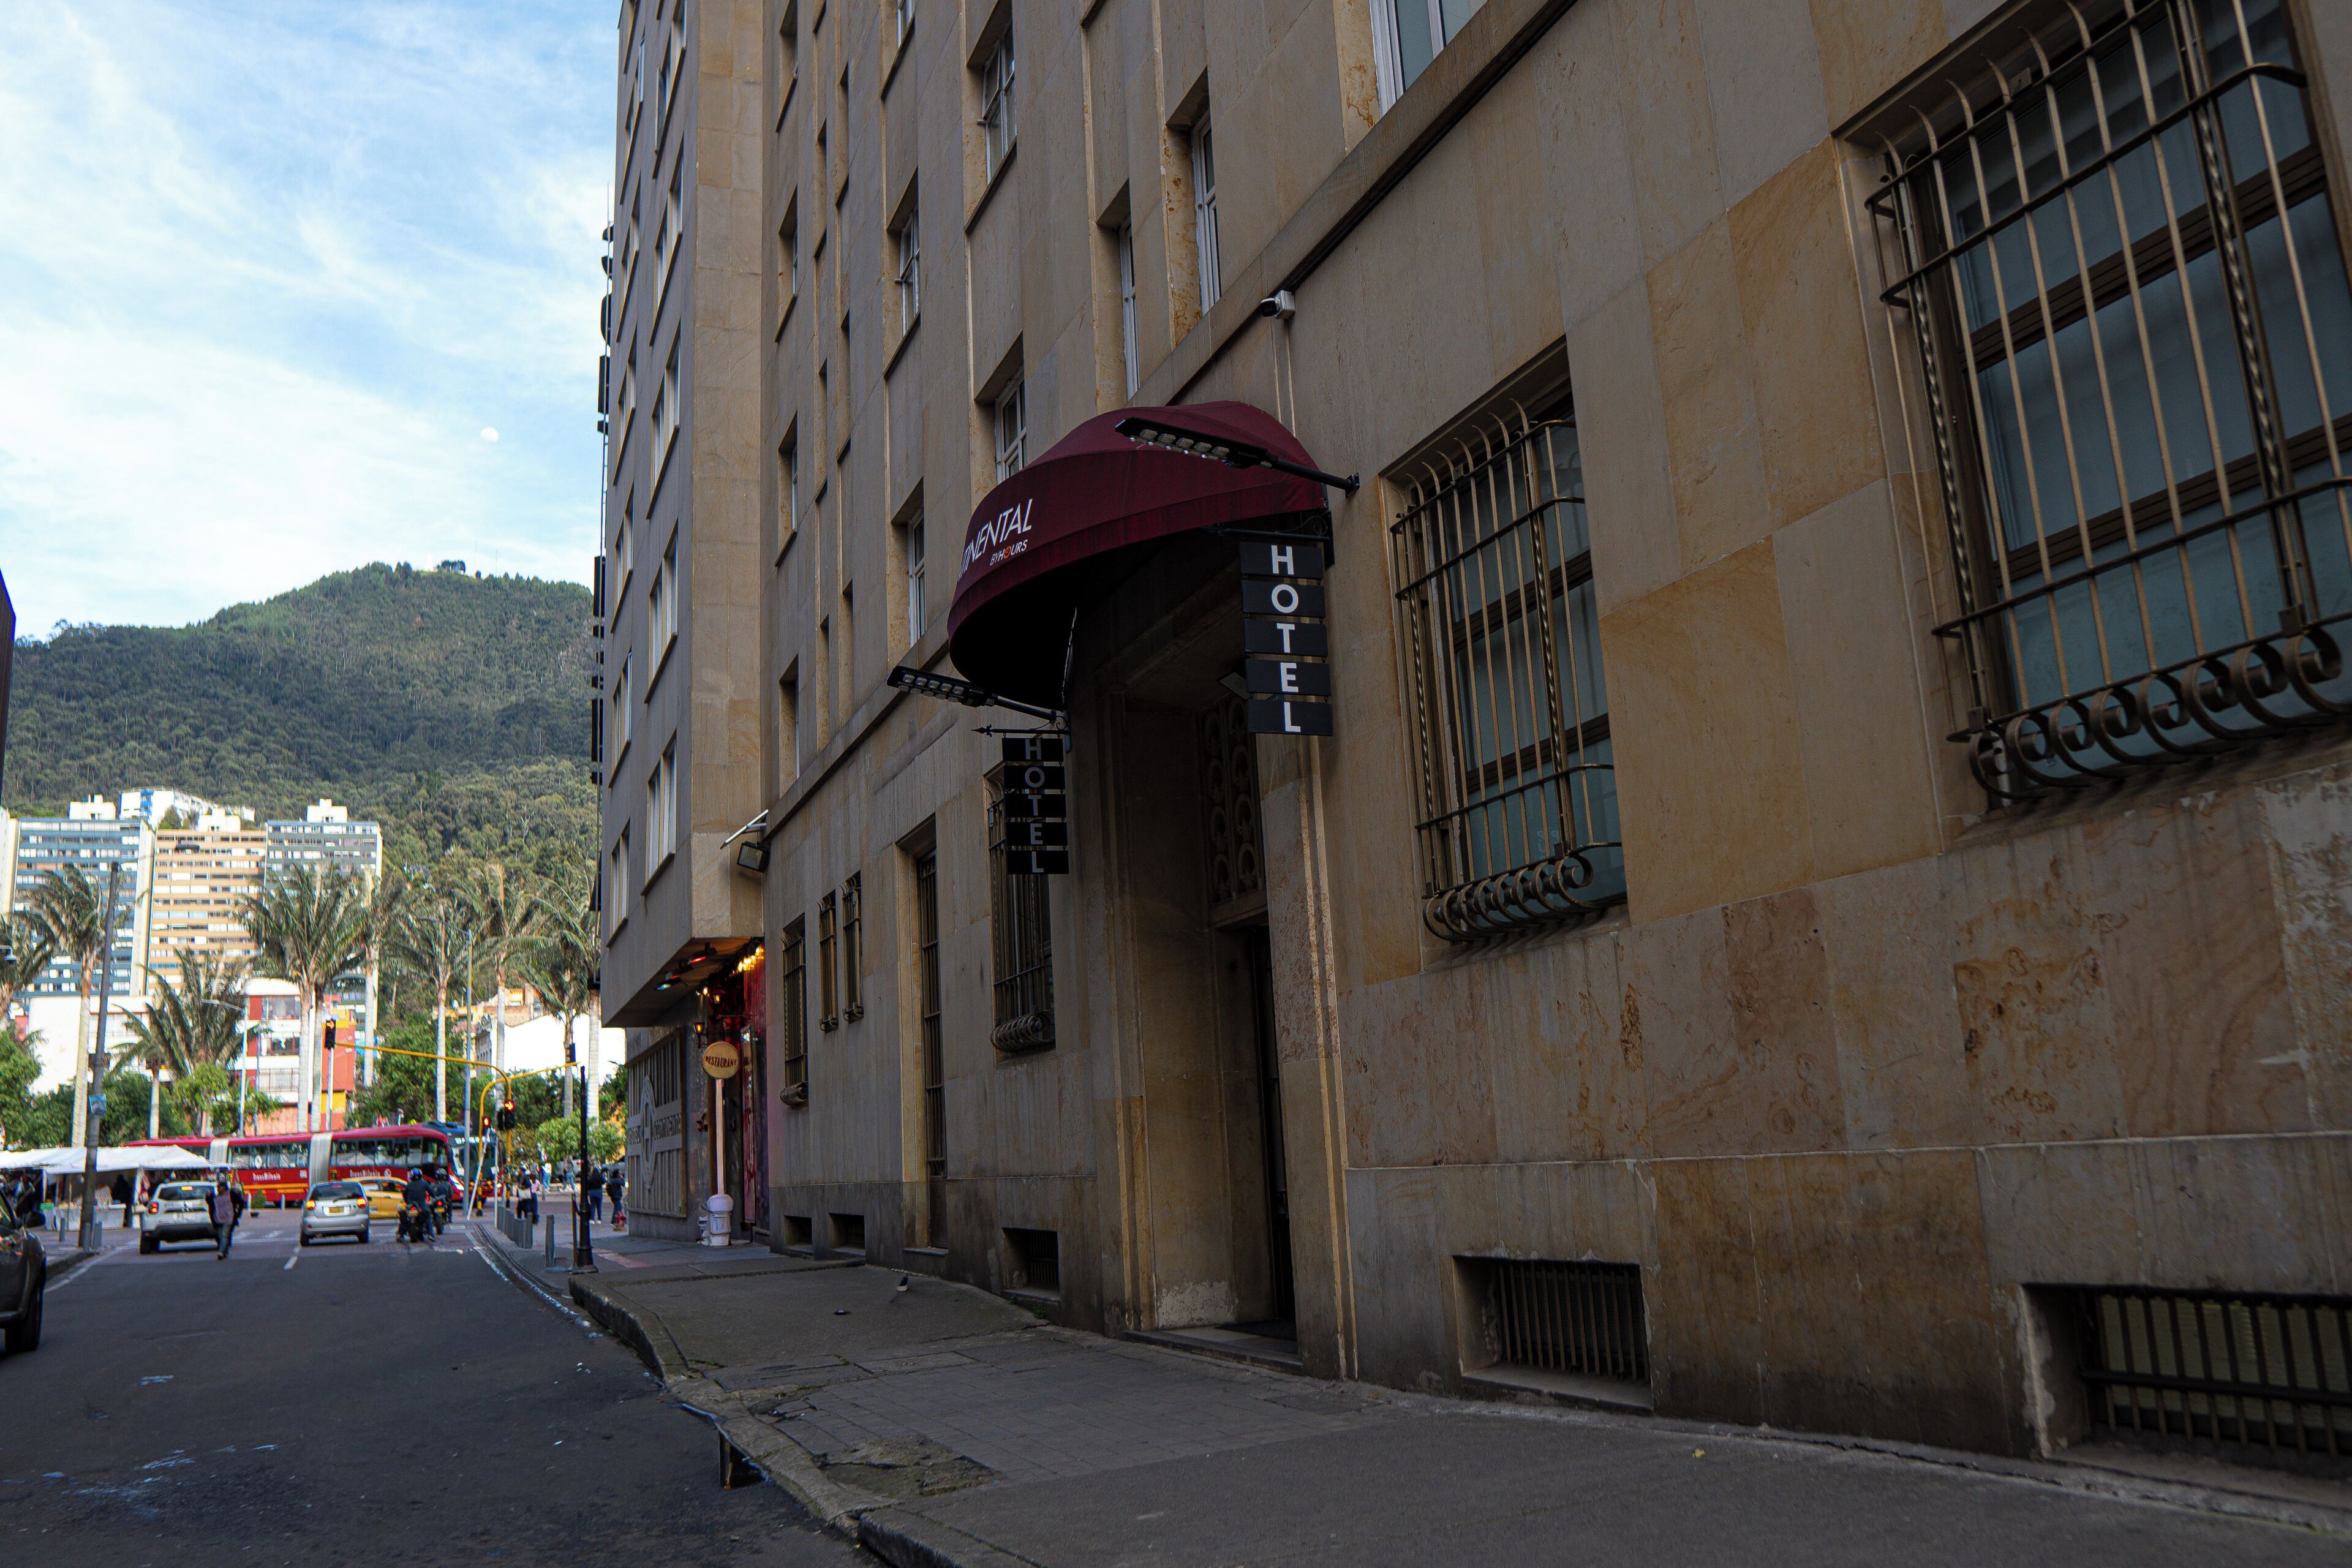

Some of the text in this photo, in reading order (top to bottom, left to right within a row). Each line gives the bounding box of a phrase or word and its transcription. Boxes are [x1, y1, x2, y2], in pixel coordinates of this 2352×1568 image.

[990, 539, 1028, 566] BYHOURS
[1271, 545, 1302, 733] HOTEL
[1025, 738, 1045, 873] HOTEL
[705, 1055, 737, 1069] RESTAURANT
